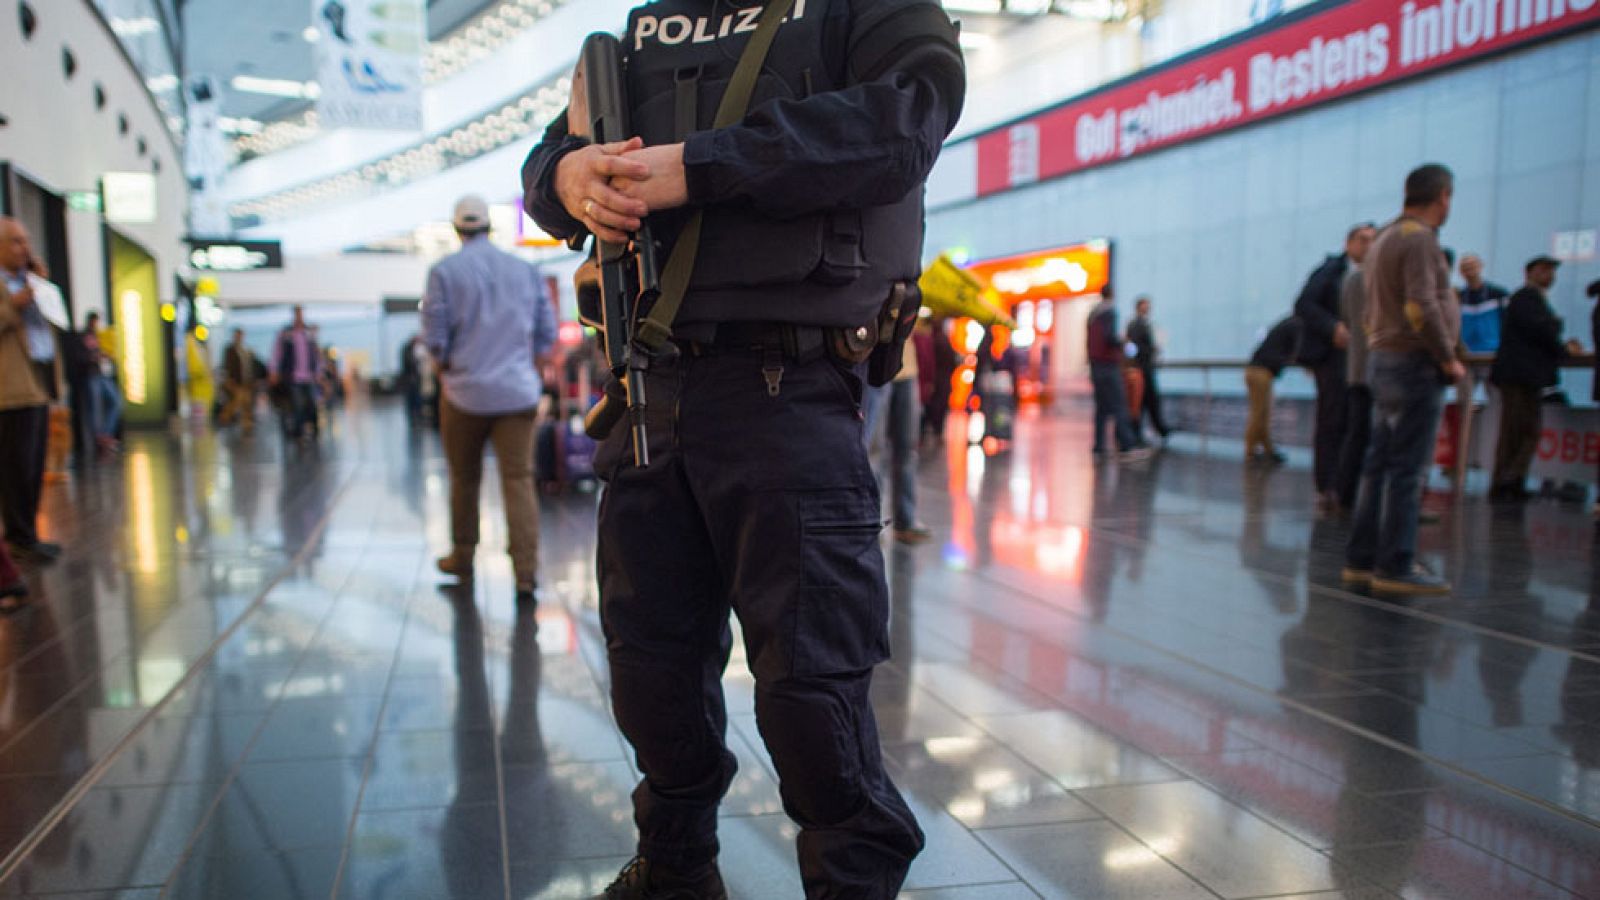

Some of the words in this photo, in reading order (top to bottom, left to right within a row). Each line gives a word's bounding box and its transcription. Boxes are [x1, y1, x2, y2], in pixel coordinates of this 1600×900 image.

[635, 0, 806, 51] POLIZI
[1250, 21, 1389, 112] Bestens
[1400, 0, 1597, 66] inform
